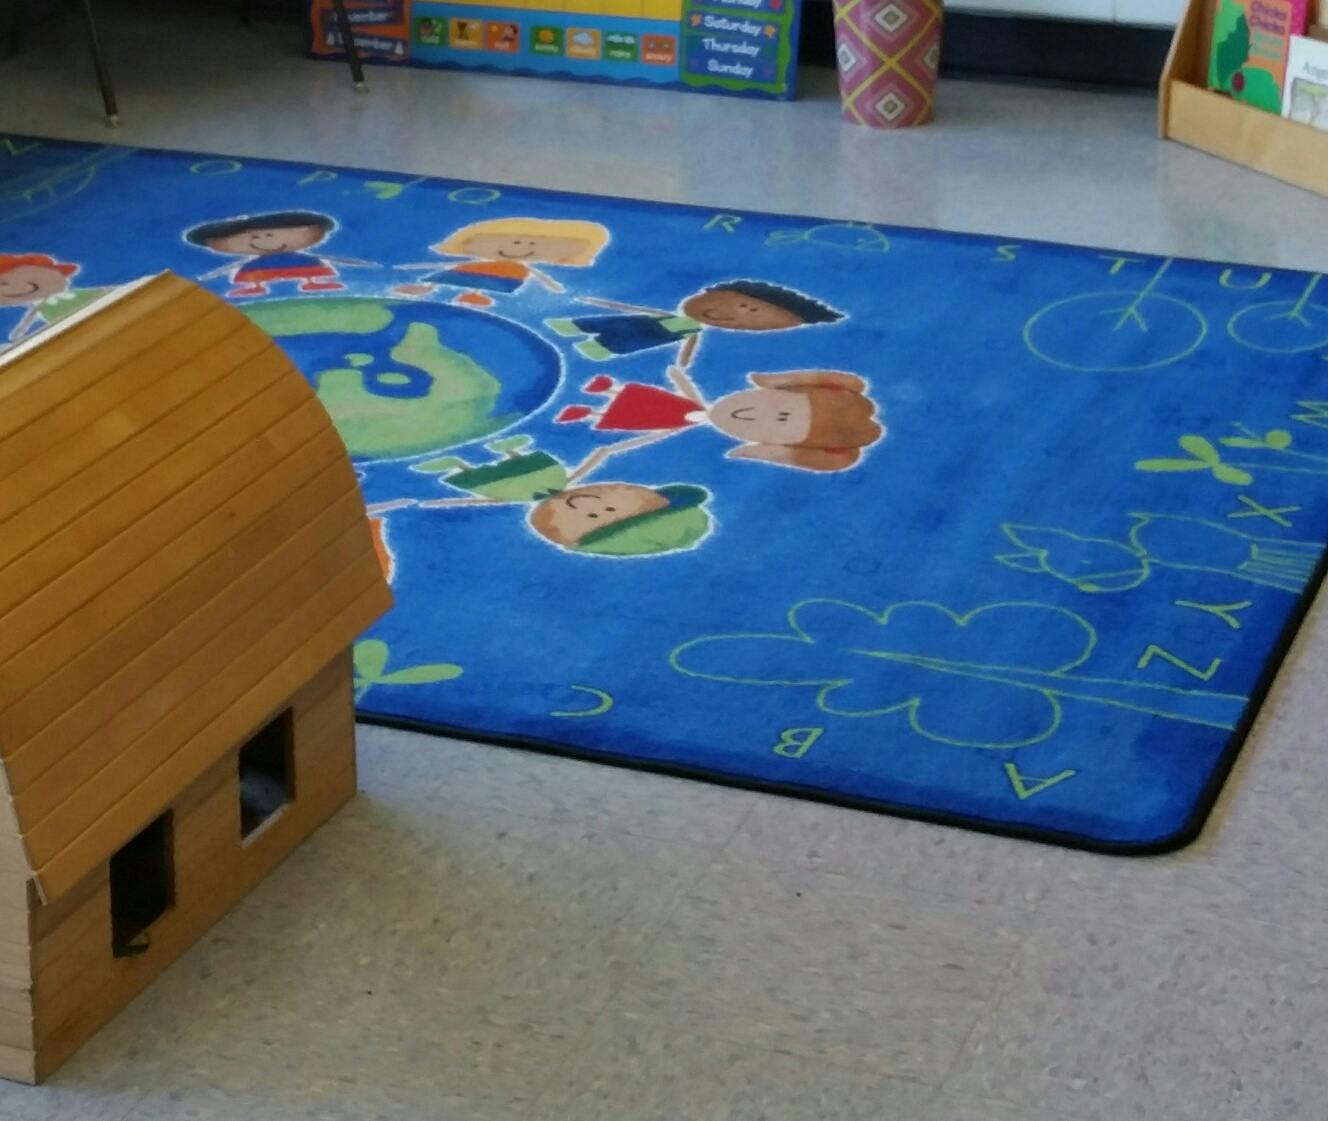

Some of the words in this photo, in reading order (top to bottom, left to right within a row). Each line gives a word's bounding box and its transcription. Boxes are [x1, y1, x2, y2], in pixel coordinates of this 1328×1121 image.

[703, 15, 762, 37] Saturday
[702, 38, 761, 57] Thursday
[707, 59, 754, 79] Sunday
[703, 214, 742, 234] R
[992, 245, 1022, 263] S
[1099, 255, 1141, 276] T
[1219, 269, 1271, 290] U
[1227, 495, 1302, 528] X
[1174, 599, 1253, 630] Y
[1137, 643, 1224, 682] Z
[550, 684, 614, 718] C
[773, 726, 824, 759] B
[1003, 762, 1076, 800] A
